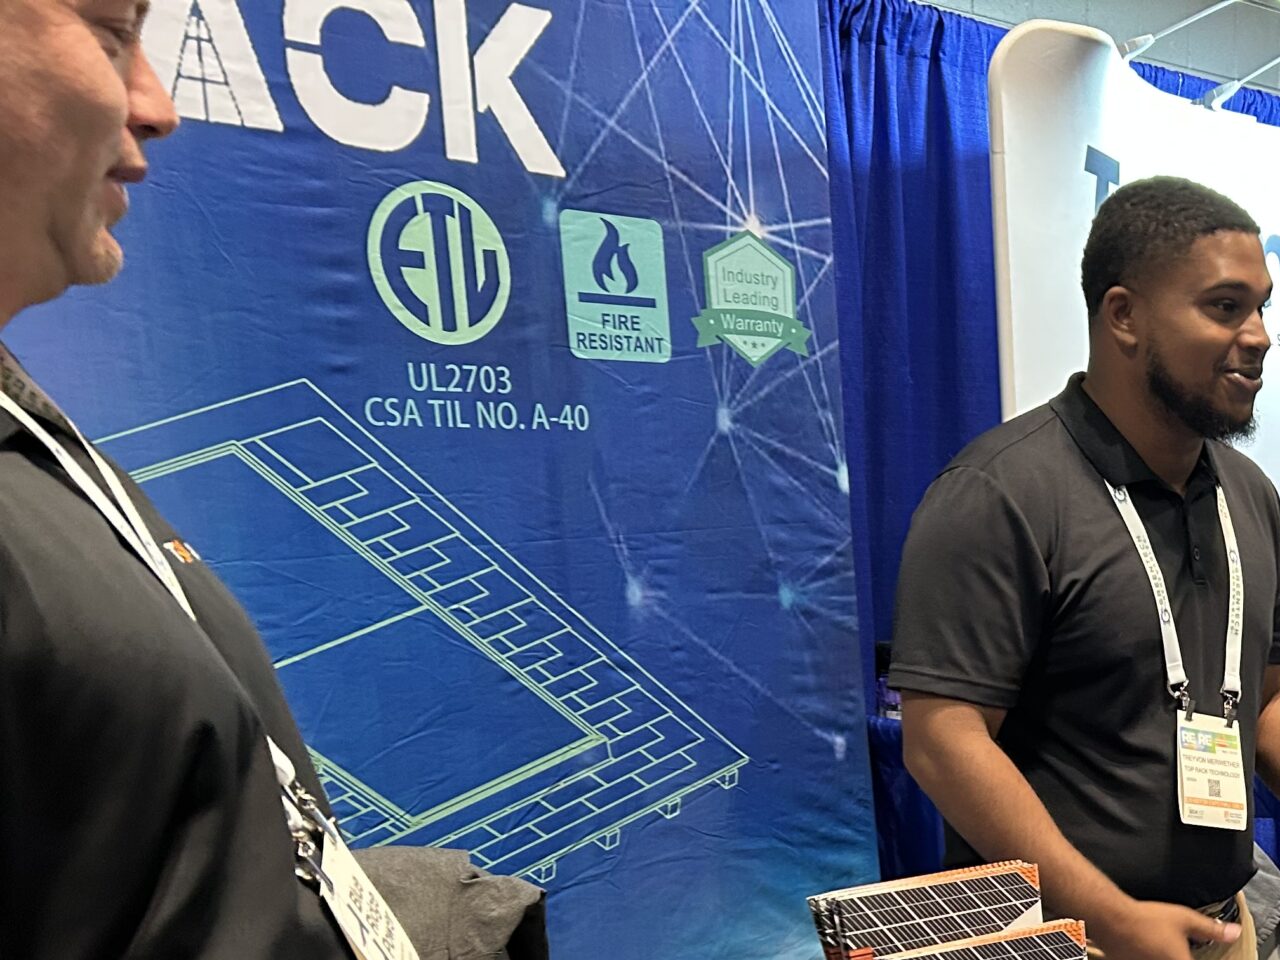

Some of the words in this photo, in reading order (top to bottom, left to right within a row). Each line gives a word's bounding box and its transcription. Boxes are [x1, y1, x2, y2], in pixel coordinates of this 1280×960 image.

[722, 266, 778, 288] Industry
[723, 290, 779, 312] Leading
[601, 313, 640, 331] FIRE
[720, 312, 785, 337] Warranty
[576, 332, 664, 354] RESISTANT
[407, 362, 513, 394] UL2703
[364, 396, 423, 428] CSA
[427, 399, 471, 428] TIL
[475, 401, 526, 430] NO.
[532, 403, 590, 431] A-40
